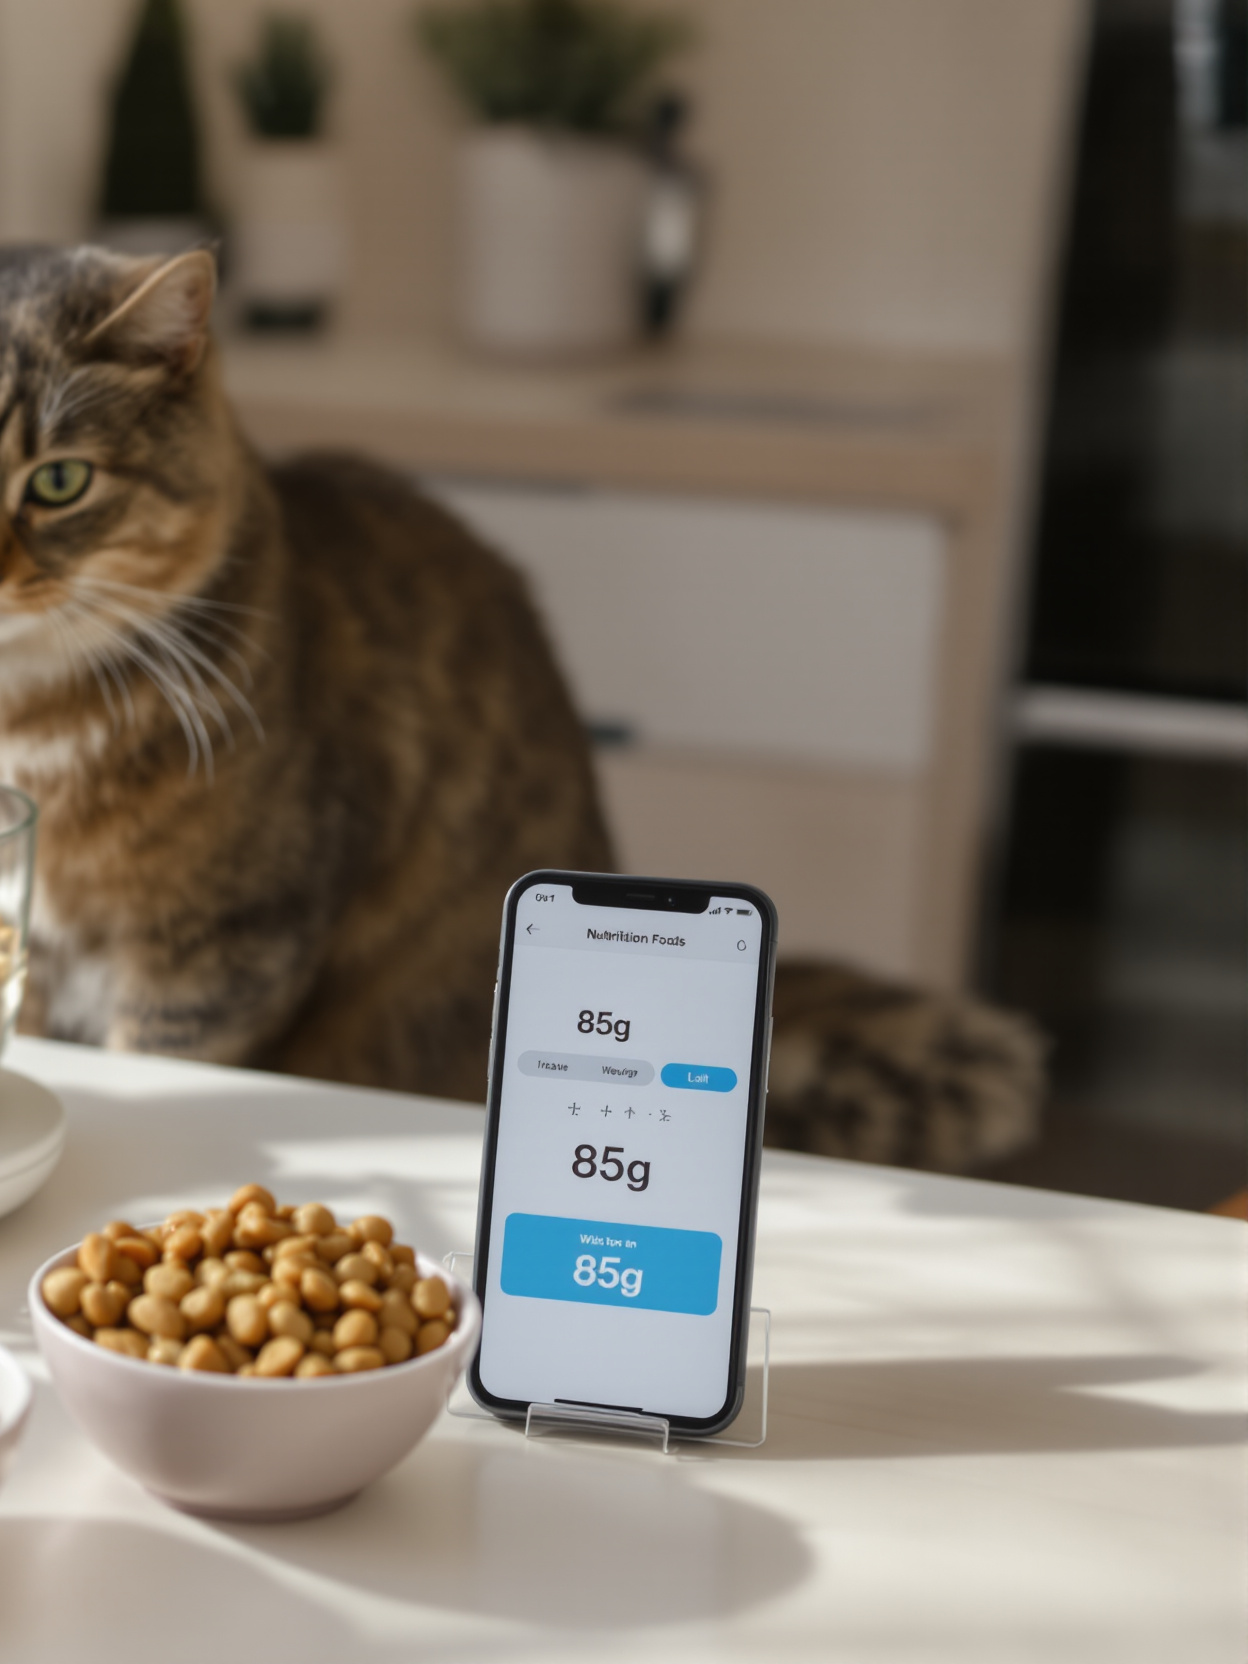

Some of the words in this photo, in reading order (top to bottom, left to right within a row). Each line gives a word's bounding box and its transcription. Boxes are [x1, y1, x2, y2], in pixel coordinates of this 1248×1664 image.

[577, 1010, 631, 1042] 85g
[572, 1144, 651, 1192] 85g
[573, 1254, 643, 1298] 85g
